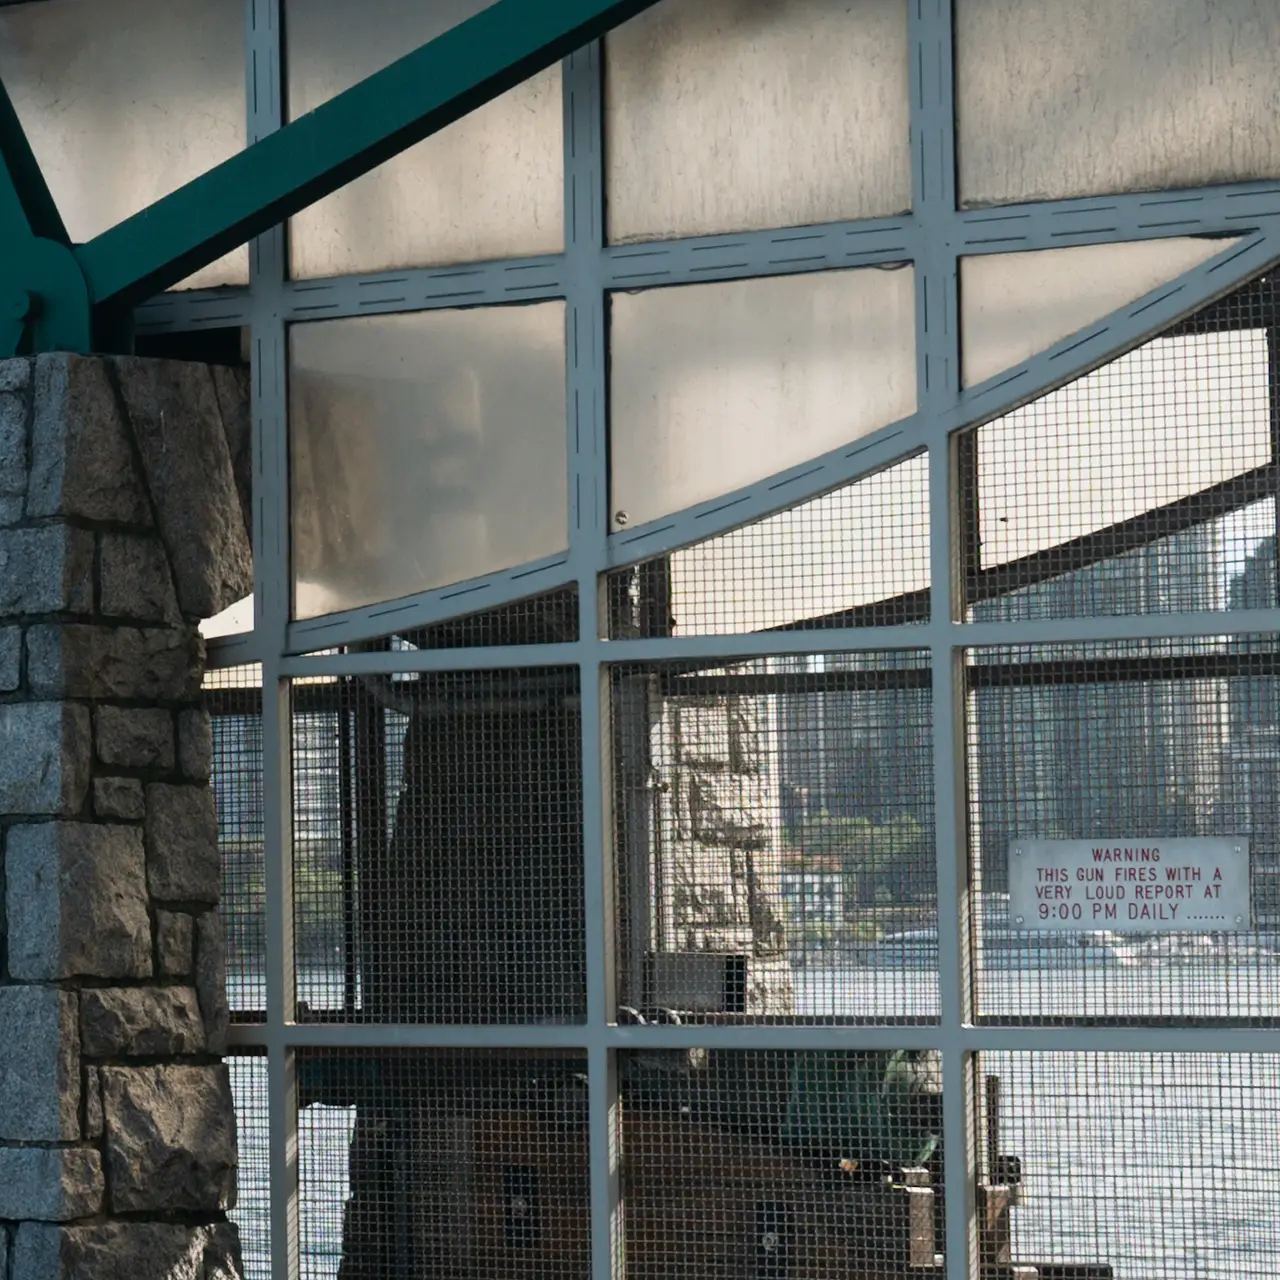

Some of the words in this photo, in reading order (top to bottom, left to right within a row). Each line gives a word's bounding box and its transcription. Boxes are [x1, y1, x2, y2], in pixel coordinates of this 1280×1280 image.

[1092, 848, 1160, 862] WARNING
[1037, 868, 1068, 882] THIS
[1077, 868, 1104, 881] GUN
[1115, 867, 1157, 881] FIRES
[1165, 867, 1201, 881] WITH
[1213, 867, 1222, 881] A
[1035, 886, 1072, 899] VERY
[1086, 886, 1125, 899] LOUD
[1135, 885, 1193, 899] REPORT
[1204, 885, 1221, 898] AT
[1038, 903, 1082, 919] 9:00
[1092, 903, 1117, 919] PM
[1128, 902, 1179, 919] DAILY
